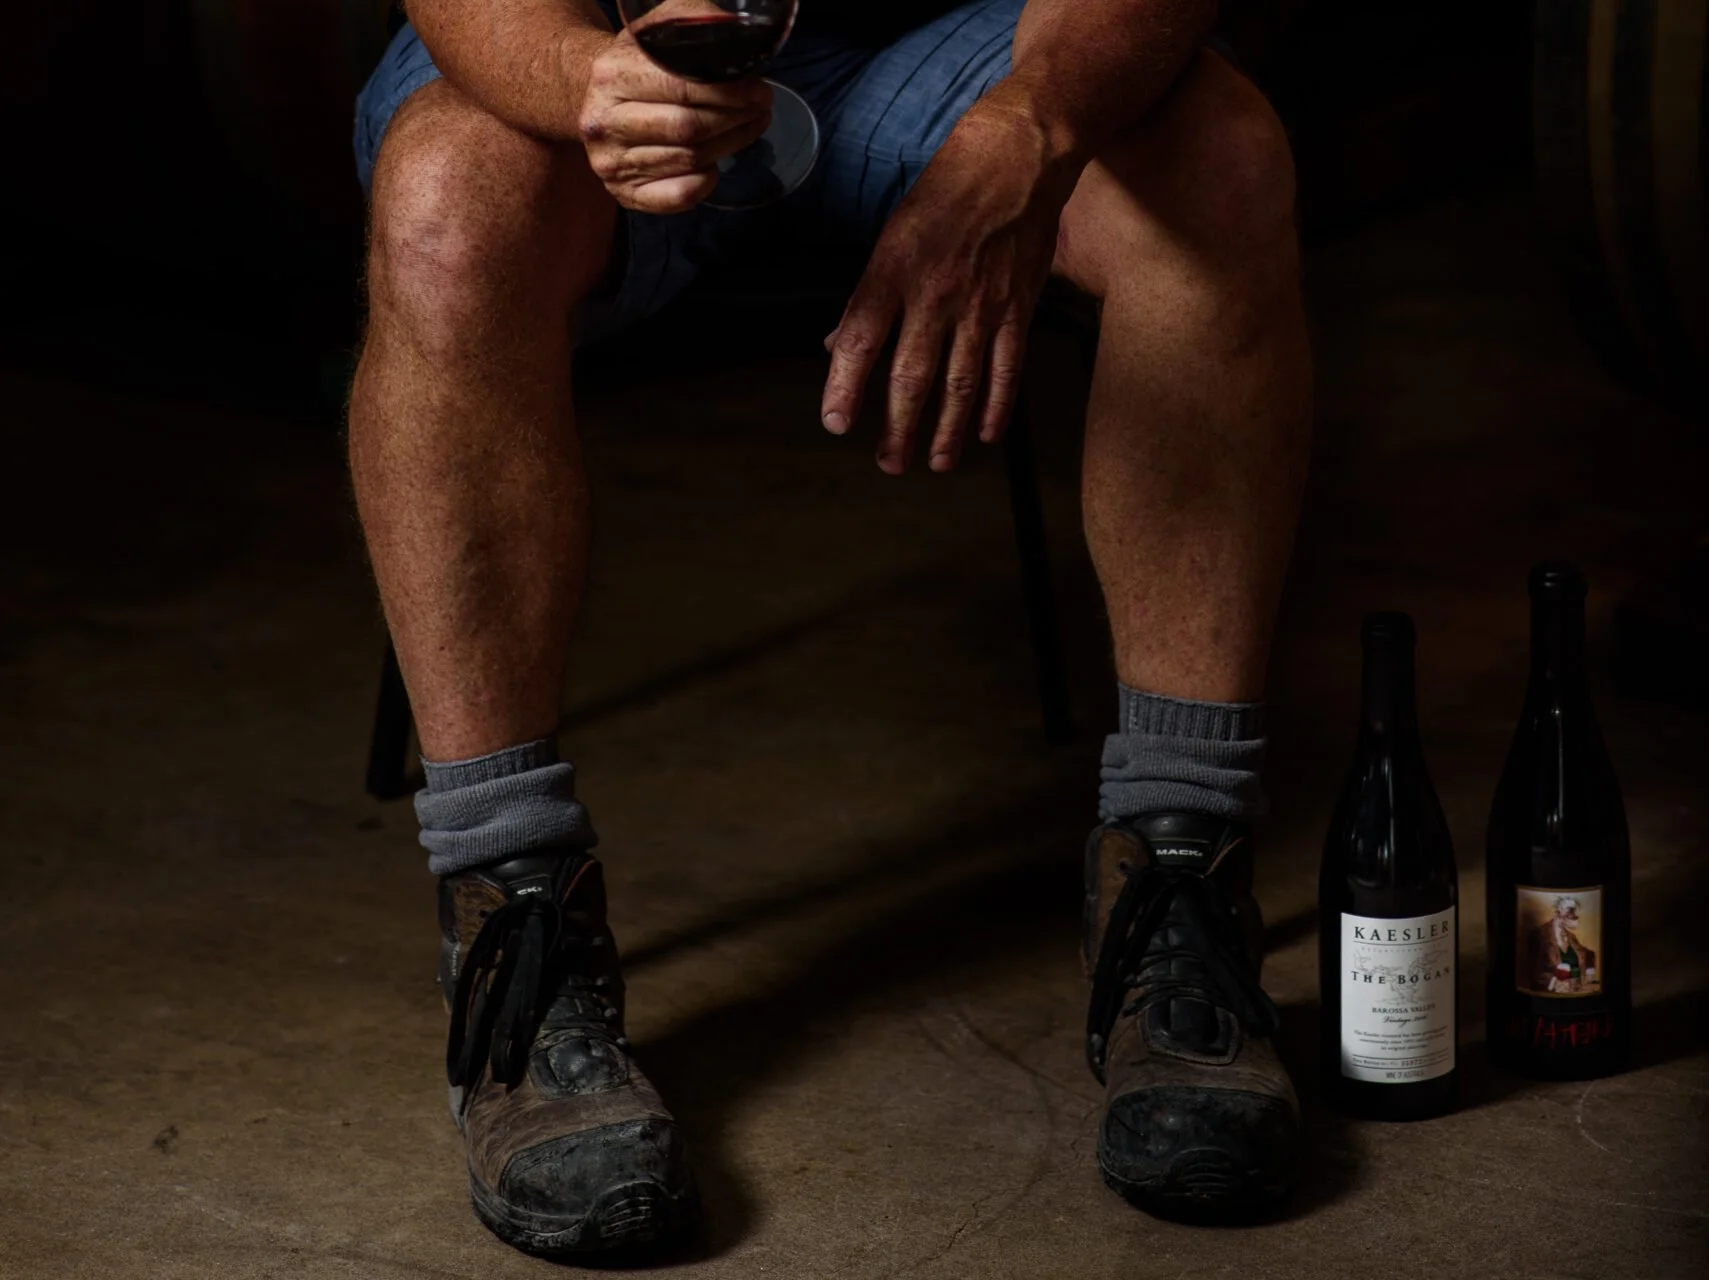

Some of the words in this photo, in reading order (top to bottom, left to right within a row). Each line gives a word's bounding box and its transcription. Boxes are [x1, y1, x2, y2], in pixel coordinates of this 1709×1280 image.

[1155, 849, 1198, 857] MACK
[1354, 920, 1449, 941] KAESLER
[1351, 971, 1386, 984] THE
[1398, 966, 1450, 984] BOGAN
